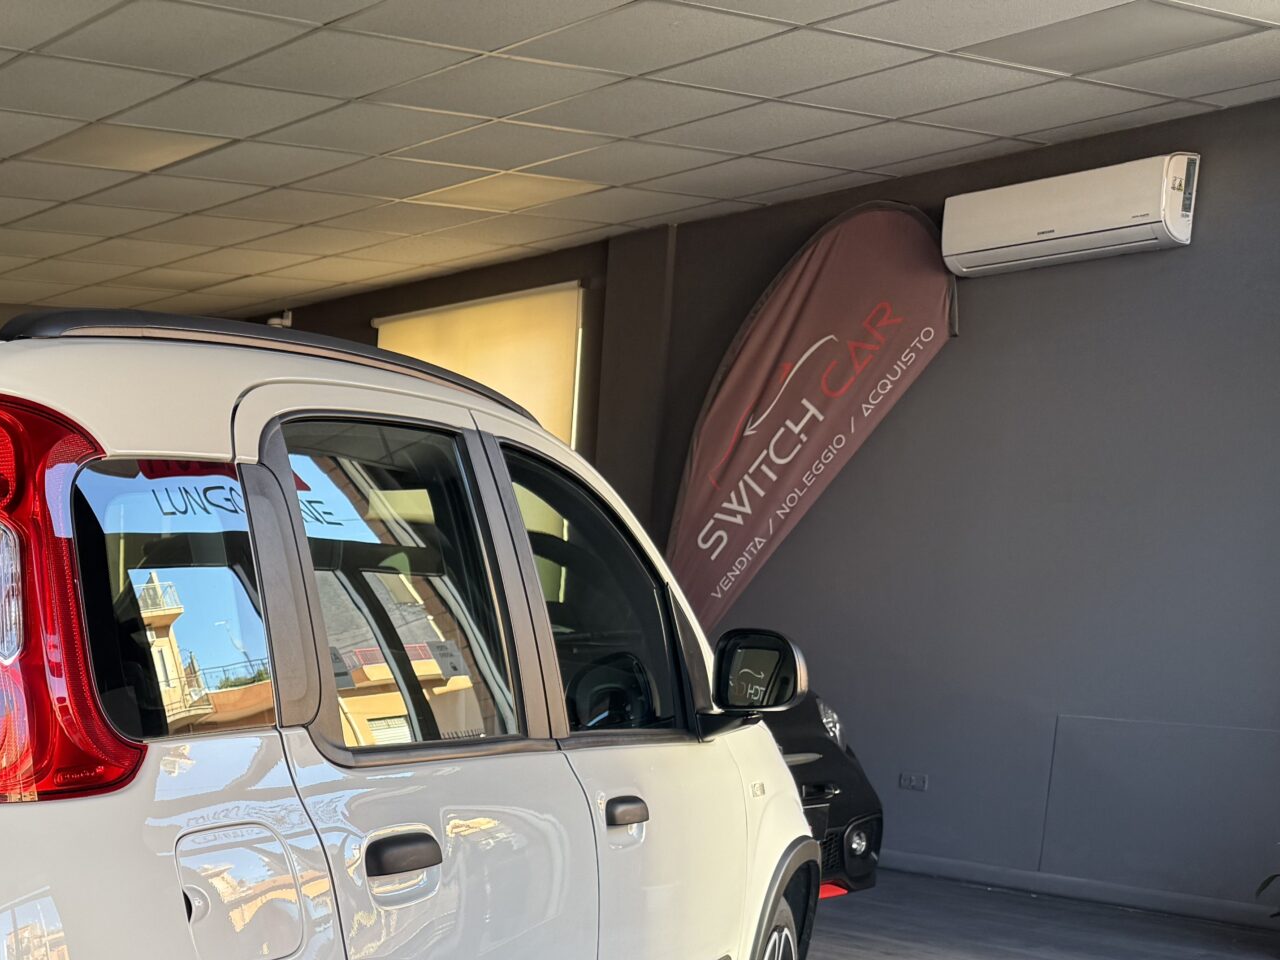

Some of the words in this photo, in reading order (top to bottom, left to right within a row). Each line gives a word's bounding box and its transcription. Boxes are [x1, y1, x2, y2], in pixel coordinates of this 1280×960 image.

[696, 398, 825, 561] SWITCH
[820, 301, 905, 398] CAR
[711, 535, 767, 599] VENDITA
[776, 433, 846, 520] NOLEGGIO
[861, 326, 935, 417] ACQUISTO
